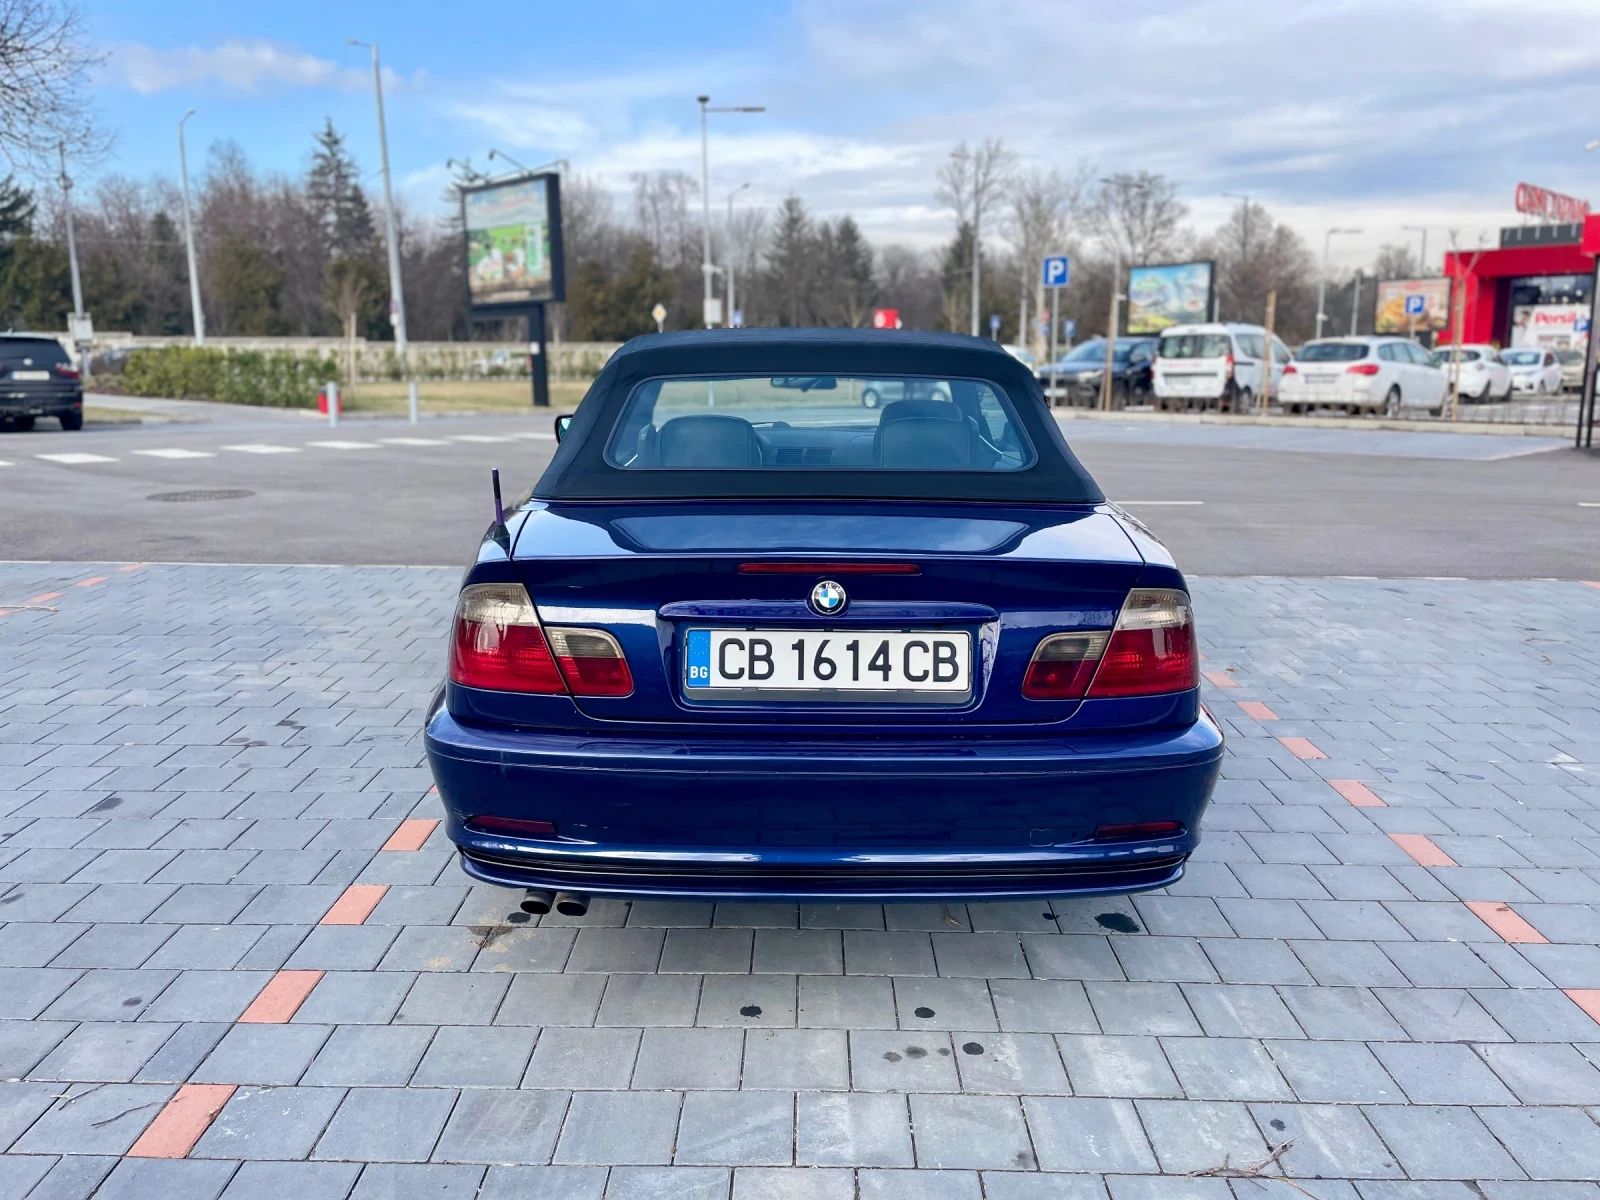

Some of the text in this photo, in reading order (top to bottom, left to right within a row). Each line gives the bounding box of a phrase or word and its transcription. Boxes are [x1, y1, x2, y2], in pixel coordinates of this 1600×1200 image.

[1048, 260, 1064, 284] P
[1409, 297, 1420, 313] P
[1535, 311, 1576, 325] Persil
[718, 638, 960, 683] CB 1614 CB
[689, 666, 708, 679] BG
